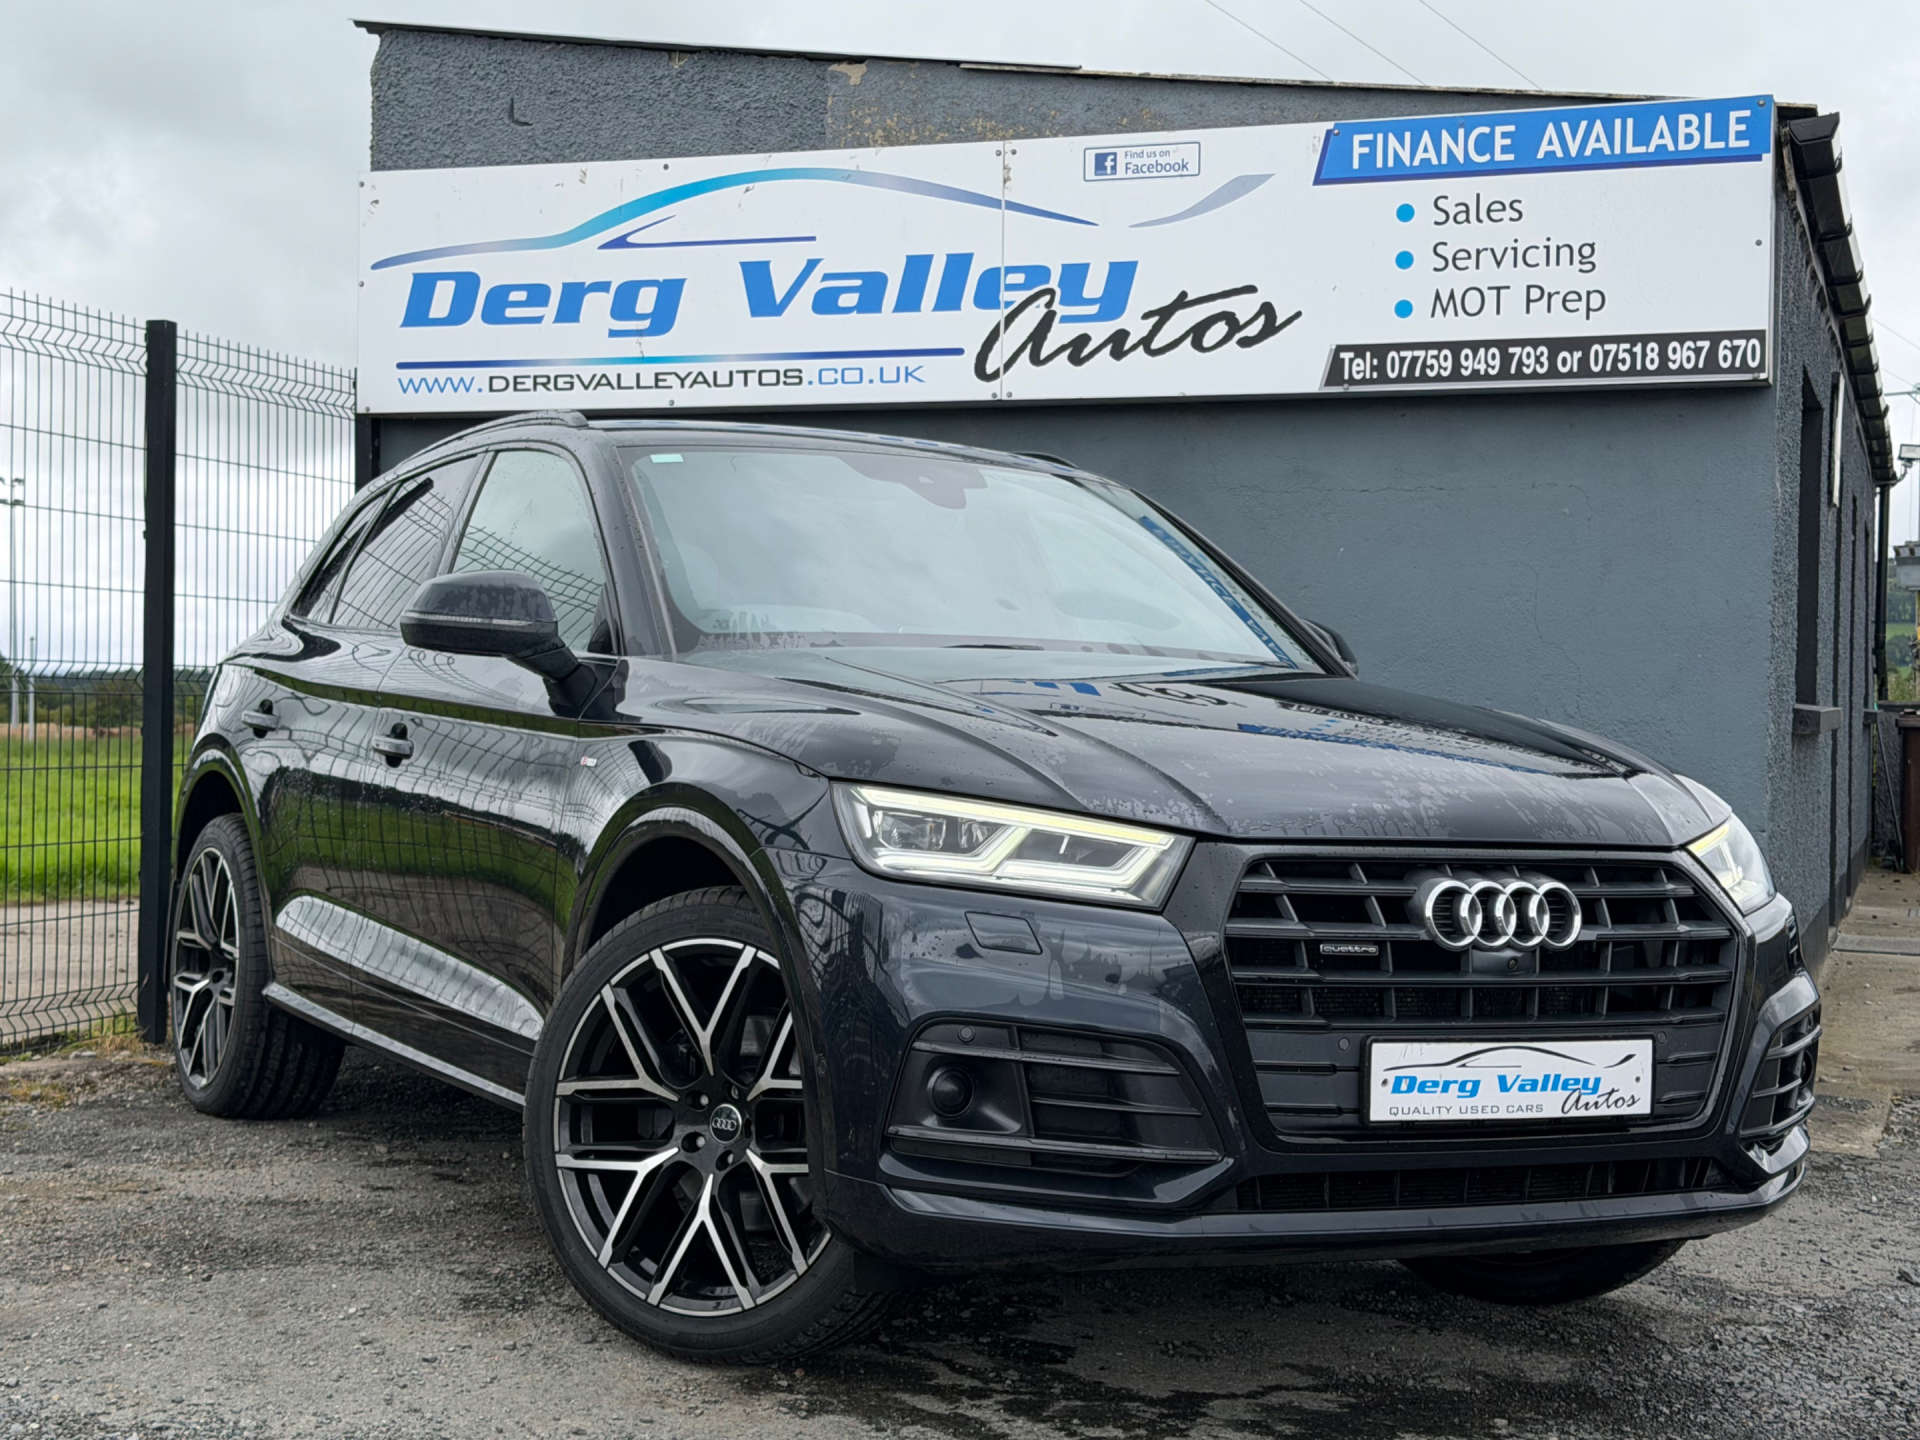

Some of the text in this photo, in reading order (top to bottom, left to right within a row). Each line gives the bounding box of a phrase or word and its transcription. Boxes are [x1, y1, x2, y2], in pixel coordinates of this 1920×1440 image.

[1124, 149, 1171, 160] Find us on
[1352, 109, 1752, 170] FINANCE AVAILABLE
[1124, 157, 1189, 175] Facebook
[1433, 192, 1523, 226] Sales
[1432, 237, 1597, 273] Servicing
[400, 252, 1138, 338] Derg Valley
[1430, 283, 1606, 320] MOT Prep
[974, 284, 1302, 383] Autos
[1339, 338, 1761, 380] Tel: 07759 949 793 or 07518 967 670
[1391, 1074, 1602, 1098] Derg Valley
[1561, 1087, 1640, 1115] Autos
[1389, 1103, 1544, 1117] QUALITY USED CARS
